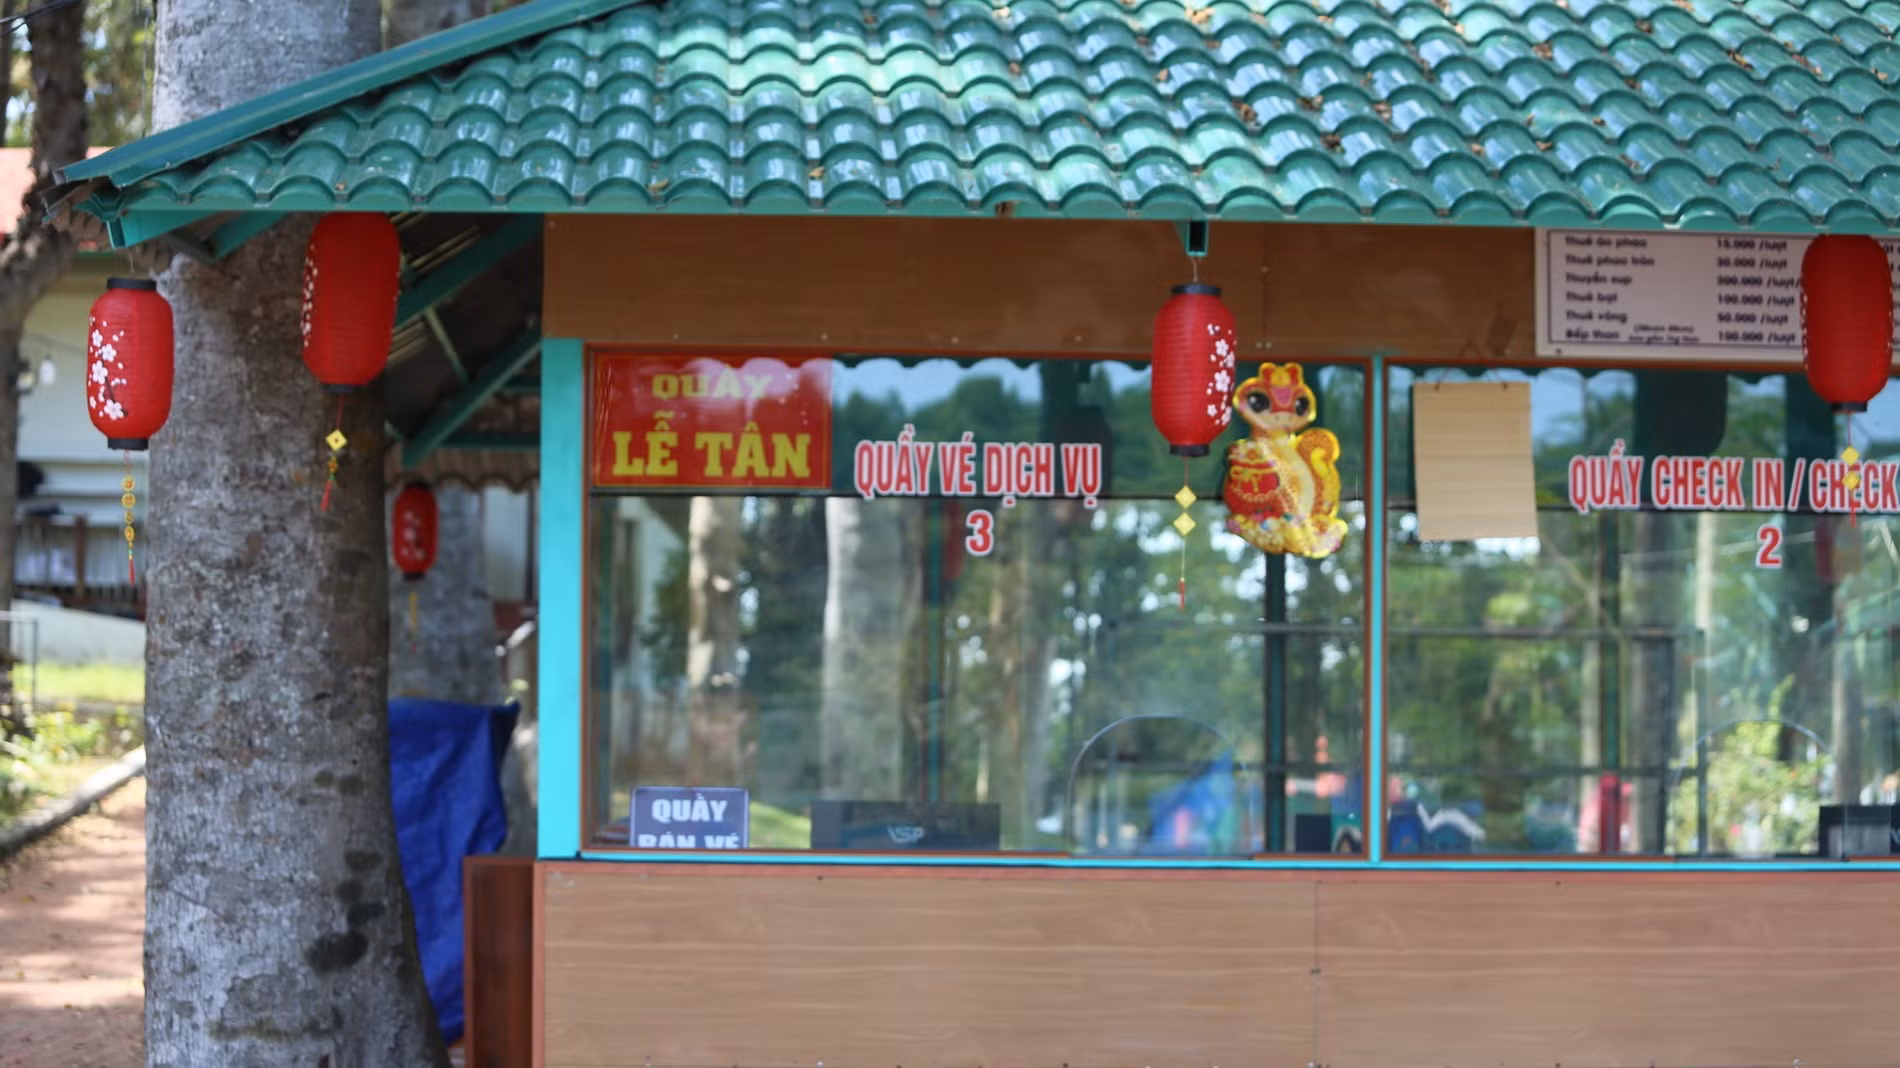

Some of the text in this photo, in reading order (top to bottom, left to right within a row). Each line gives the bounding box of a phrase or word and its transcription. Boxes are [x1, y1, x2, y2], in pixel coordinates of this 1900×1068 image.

[612, 410, 812, 478] LỄ TÂN
[938, 431, 976, 495] VÉ
[983, 442, 1054, 508] DỊCH
[1061, 442, 1102, 508] VỤ
[1651, 455, 1745, 510] CHECK
[965, 509, 994, 556] 3
[1756, 523, 1783, 568] 2
